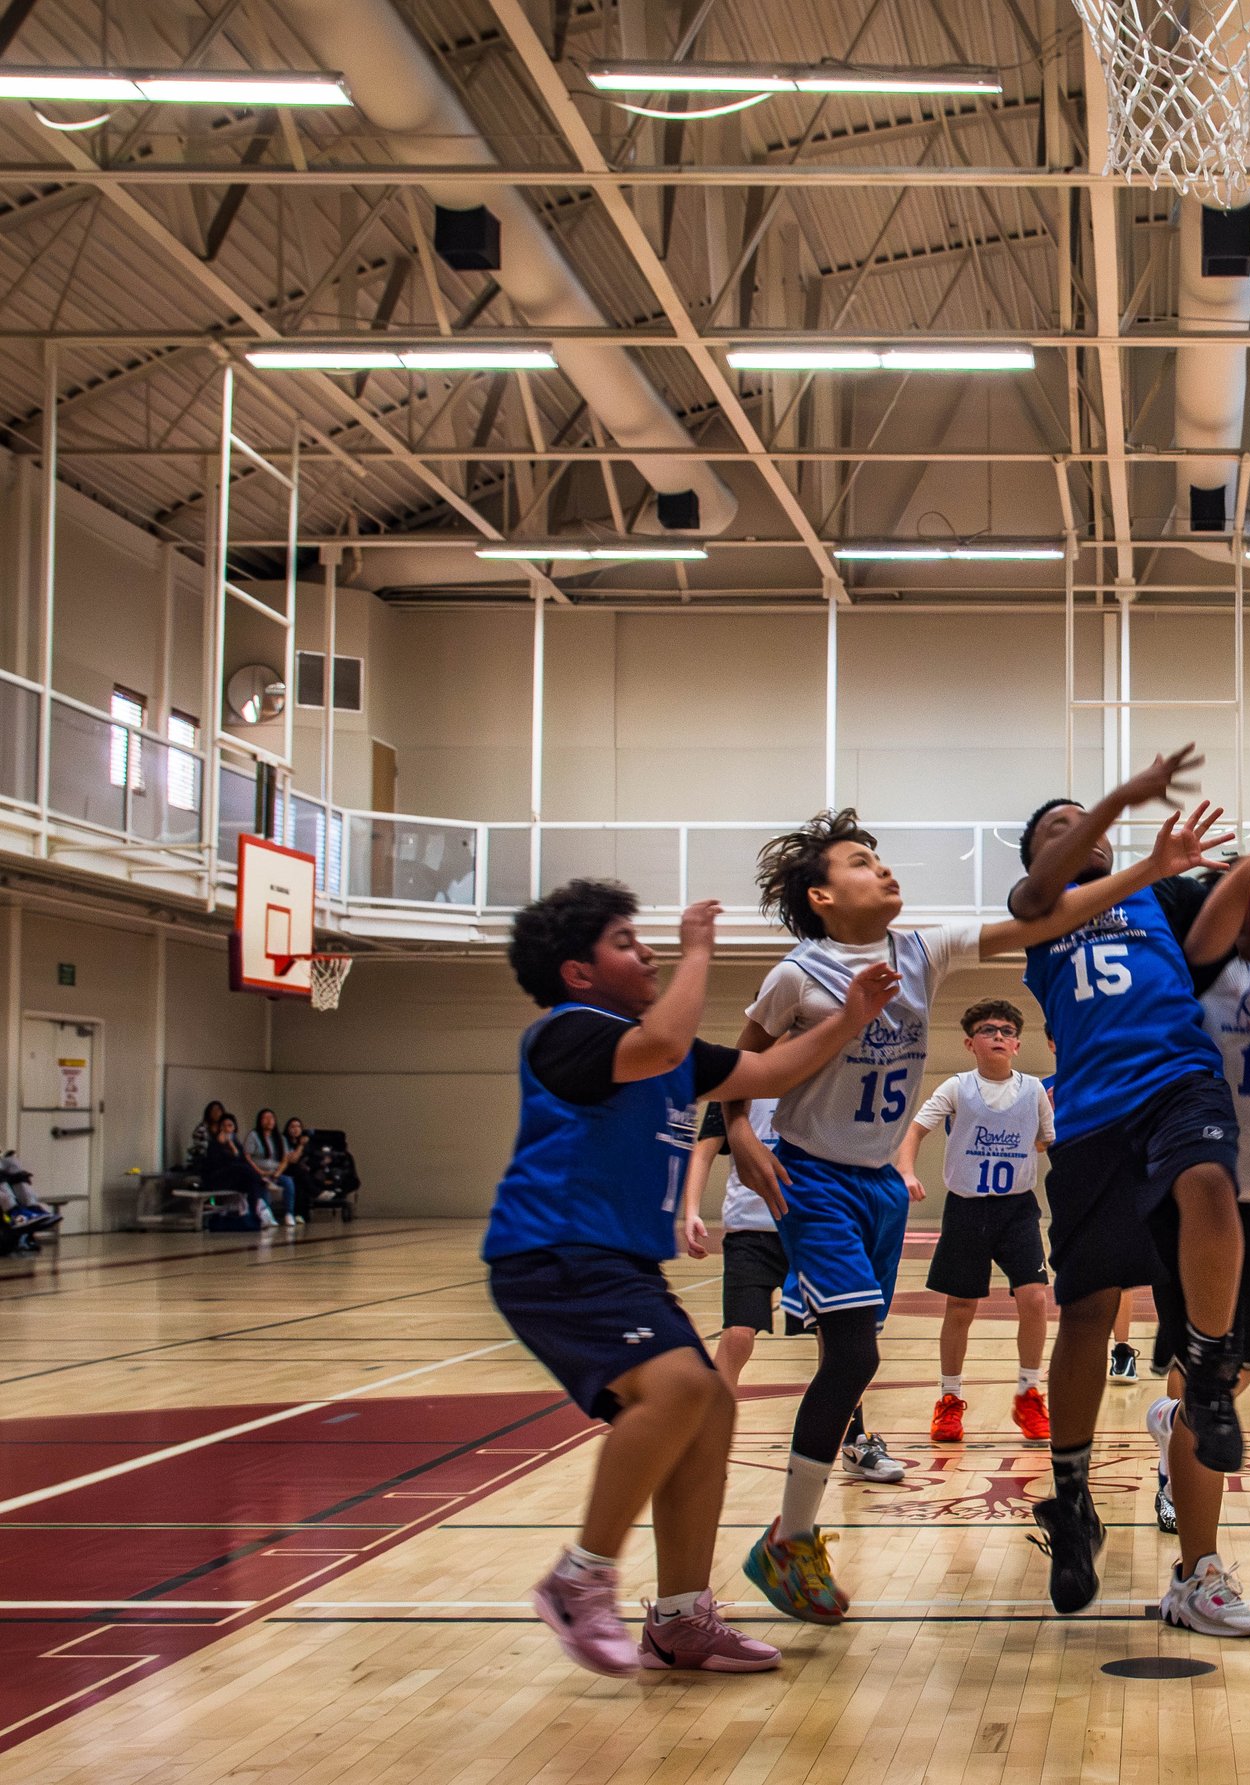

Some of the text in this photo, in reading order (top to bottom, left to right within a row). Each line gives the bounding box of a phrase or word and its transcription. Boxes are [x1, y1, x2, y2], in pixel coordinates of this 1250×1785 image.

[1070, 944, 1132, 1002] 15
[854, 1068, 908, 1123] 15
[975, 1125, 1021, 1149] Rowlett
[976, 1159, 1015, 1194] 10
